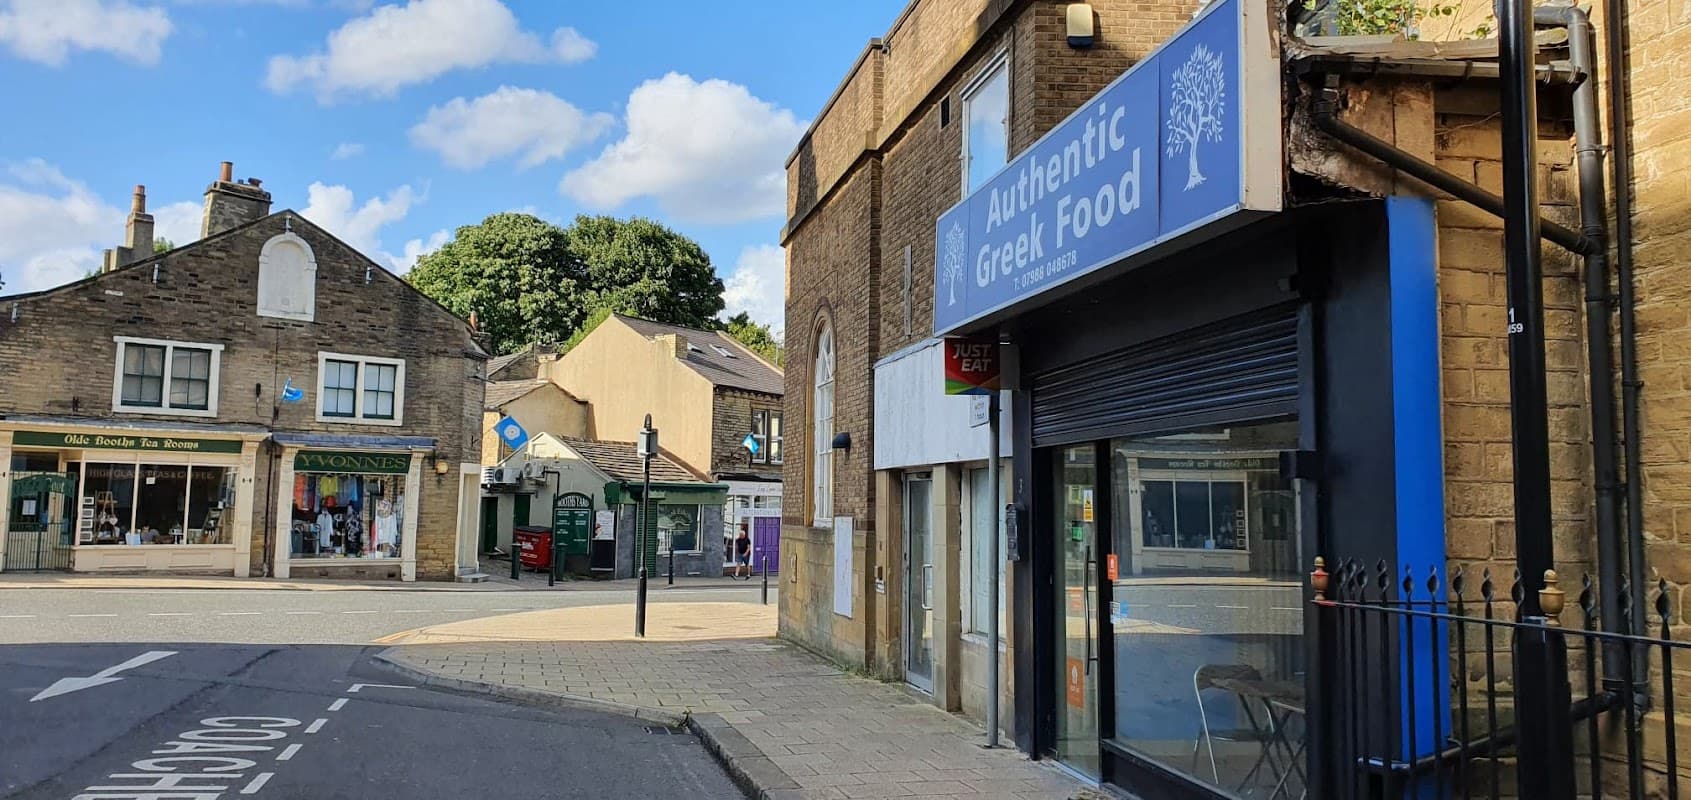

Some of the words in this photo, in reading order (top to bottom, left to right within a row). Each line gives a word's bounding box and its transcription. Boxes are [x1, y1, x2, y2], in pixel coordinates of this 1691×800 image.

[985, 102, 1126, 233] Authentic
[976, 212, 1045, 287] Greek
[1056, 147, 1141, 249] Food
[1014, 278, 1020, 292] T:
[1021, 265, 1044, 288] 07988
[1046, 249, 1077, 276] 048678
[952, 343, 992, 360] JUST
[961, 358, 992, 372] EAT
[64, 434, 90, 445] Olde
[95, 435, 135, 448] Booths
[139, 437, 158, 448] Tea
[164, 438, 199, 450] Rooms
[301, 454, 407, 469] YVONNES
